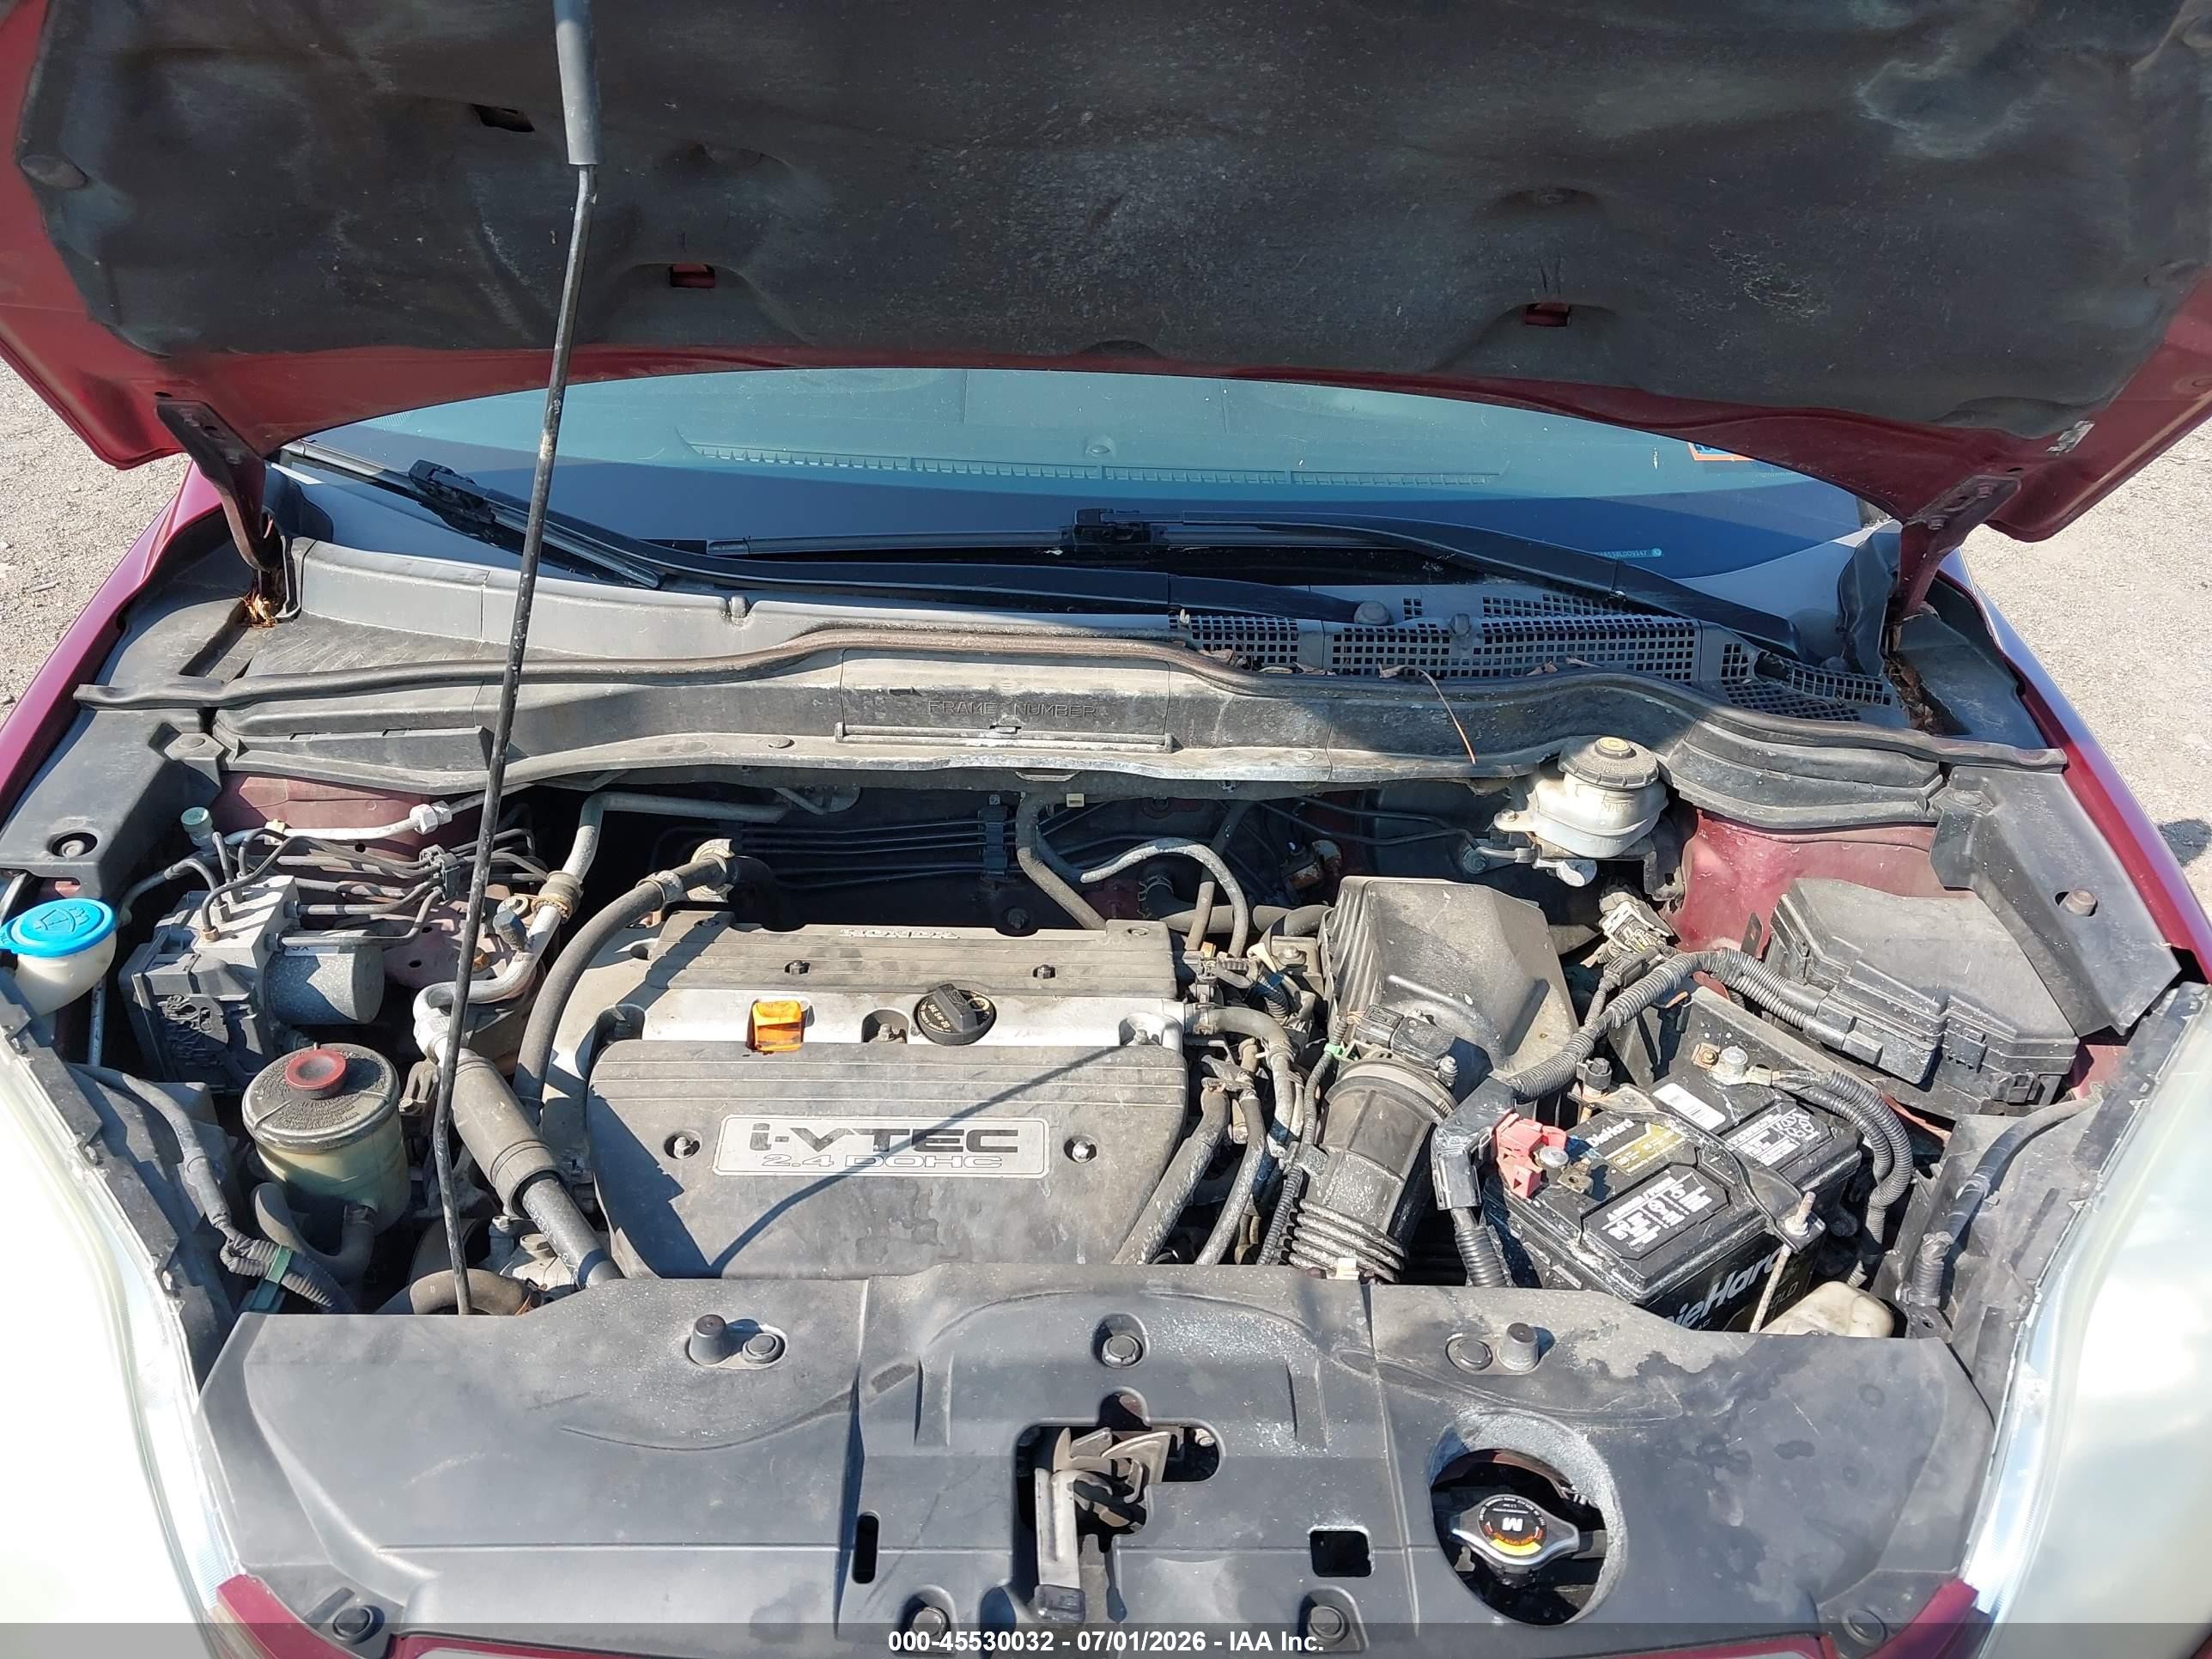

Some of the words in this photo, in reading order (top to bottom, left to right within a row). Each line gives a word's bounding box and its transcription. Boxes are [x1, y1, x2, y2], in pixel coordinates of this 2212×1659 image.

[927, 700, 998, 715] FRAME
[1013, 703, 1097, 718] NUMBER
[749, 1122, 1019, 1154] i-VTEC
[1585, 1118, 1635, 1148] DieHard
[762, 1154, 835, 1168] 2.4
[845, 1155, 1003, 1169] DOHC
[1769, 1281, 1799, 1310] OLD
